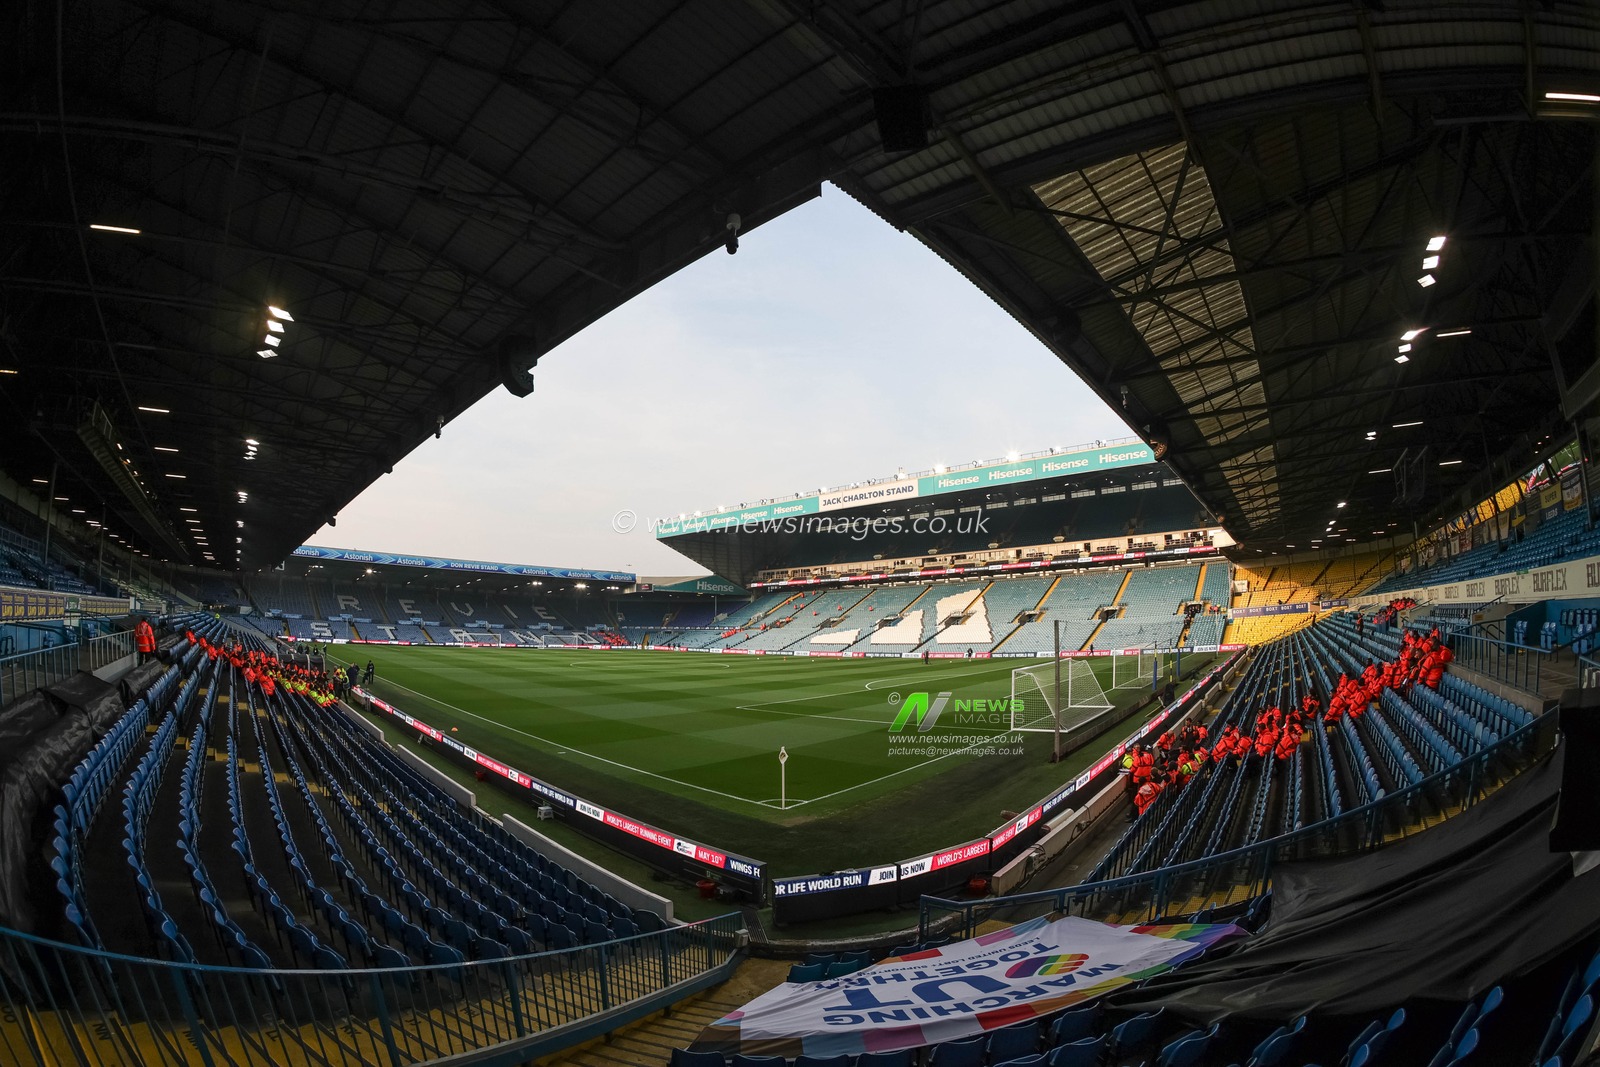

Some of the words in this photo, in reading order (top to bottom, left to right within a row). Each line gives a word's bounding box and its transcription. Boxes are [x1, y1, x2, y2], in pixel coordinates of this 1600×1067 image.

[1099, 450, 1147, 464] Hisense
[1042, 458, 1088, 472] Hisense
[988, 466, 1032, 480] Hisense
[938, 475, 979, 488] Hisense
[823, 496, 842, 506] JACK
[843, 490, 884, 503] CHARLTON
[886, 485, 914, 496] STAND
[773, 504, 803, 515] Hisense
[344, 552, 373, 561] Astonish
[397, 558, 426, 566] Astonish
[522, 567, 547, 575] Astonish
[696, 581, 734, 592] Hisense
[1494, 576, 1520, 595] BURFLEX
[1533, 568, 1567, 592] BURFLEX
[1466, 582, 1485, 597] BURFLEX
[606, 815, 622, 827] WORLD'S
[623, 822, 639, 834] LARGEST
[640, 828, 657, 842] RUNNING
[658, 835, 671, 847] EVENT
[698, 850, 710, 861] MAY
[937, 851, 963, 866] WORLD'S
[964, 842, 987, 857] LARGEST
[730, 860, 752, 874] WINGS
[879, 870, 894, 881] JOIN
[910, 862, 925, 873] NOW
[788, 882, 806, 894] LIFE
[808, 878, 841, 891] WORLD
[843, 874, 862, 886] RUN
[1009, 937, 1040, 950] LEEDS
[968, 948, 1006, 960] UNITED
[822, 963, 1124, 1025] MARCHING
